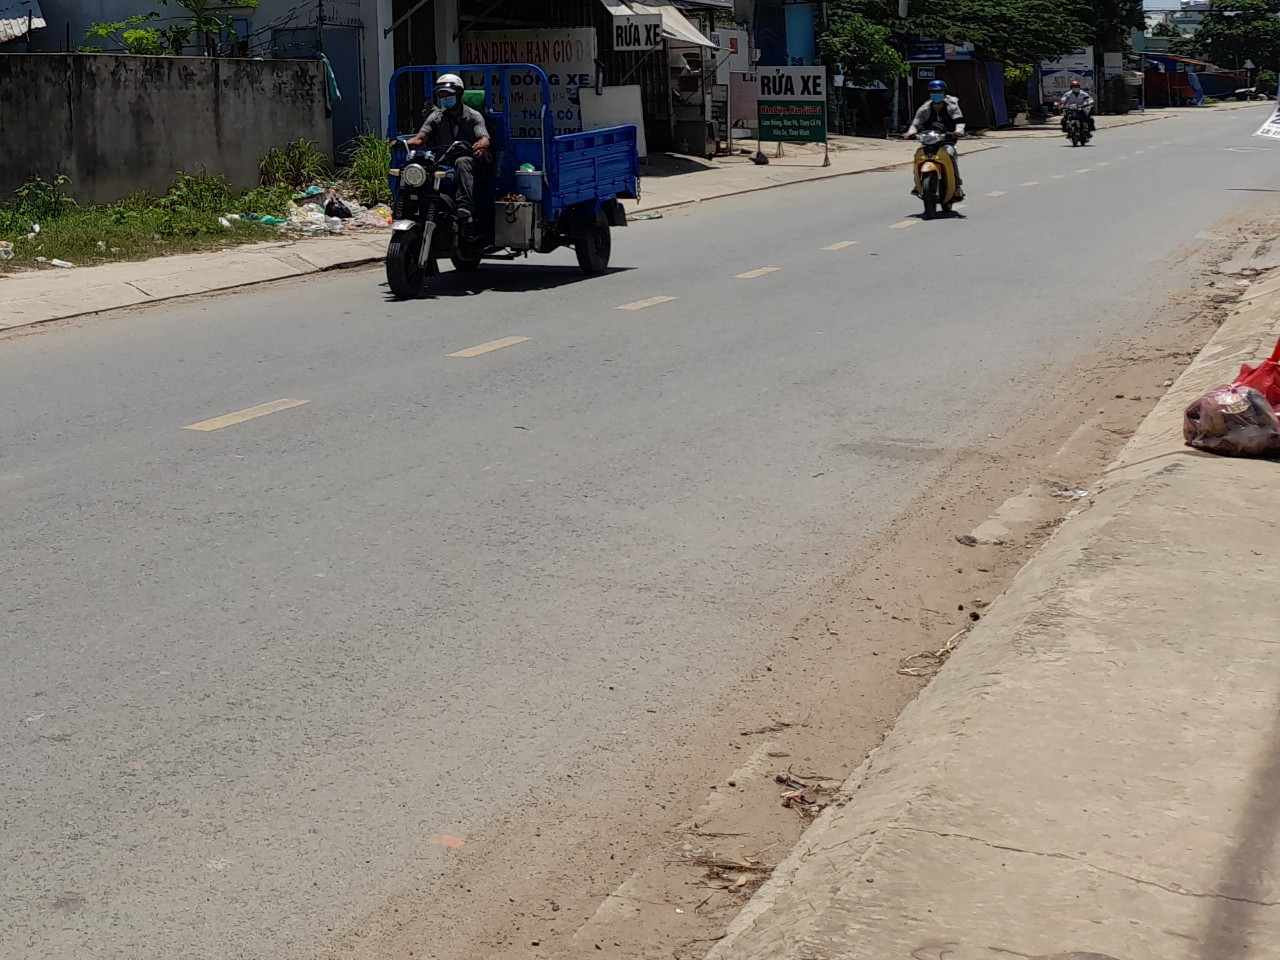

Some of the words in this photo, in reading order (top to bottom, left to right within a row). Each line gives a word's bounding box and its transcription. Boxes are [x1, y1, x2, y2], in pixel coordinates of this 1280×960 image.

[616, 18, 641, 47] RỬA
[644, 24, 661, 46] XE
[526, 34, 550, 62] HÀN
[554, 33, 573, 63] GIÓ
[566, 74, 590, 86] XE
[761, 68, 795, 96] RỬA
[800, 75, 823, 96] XE
